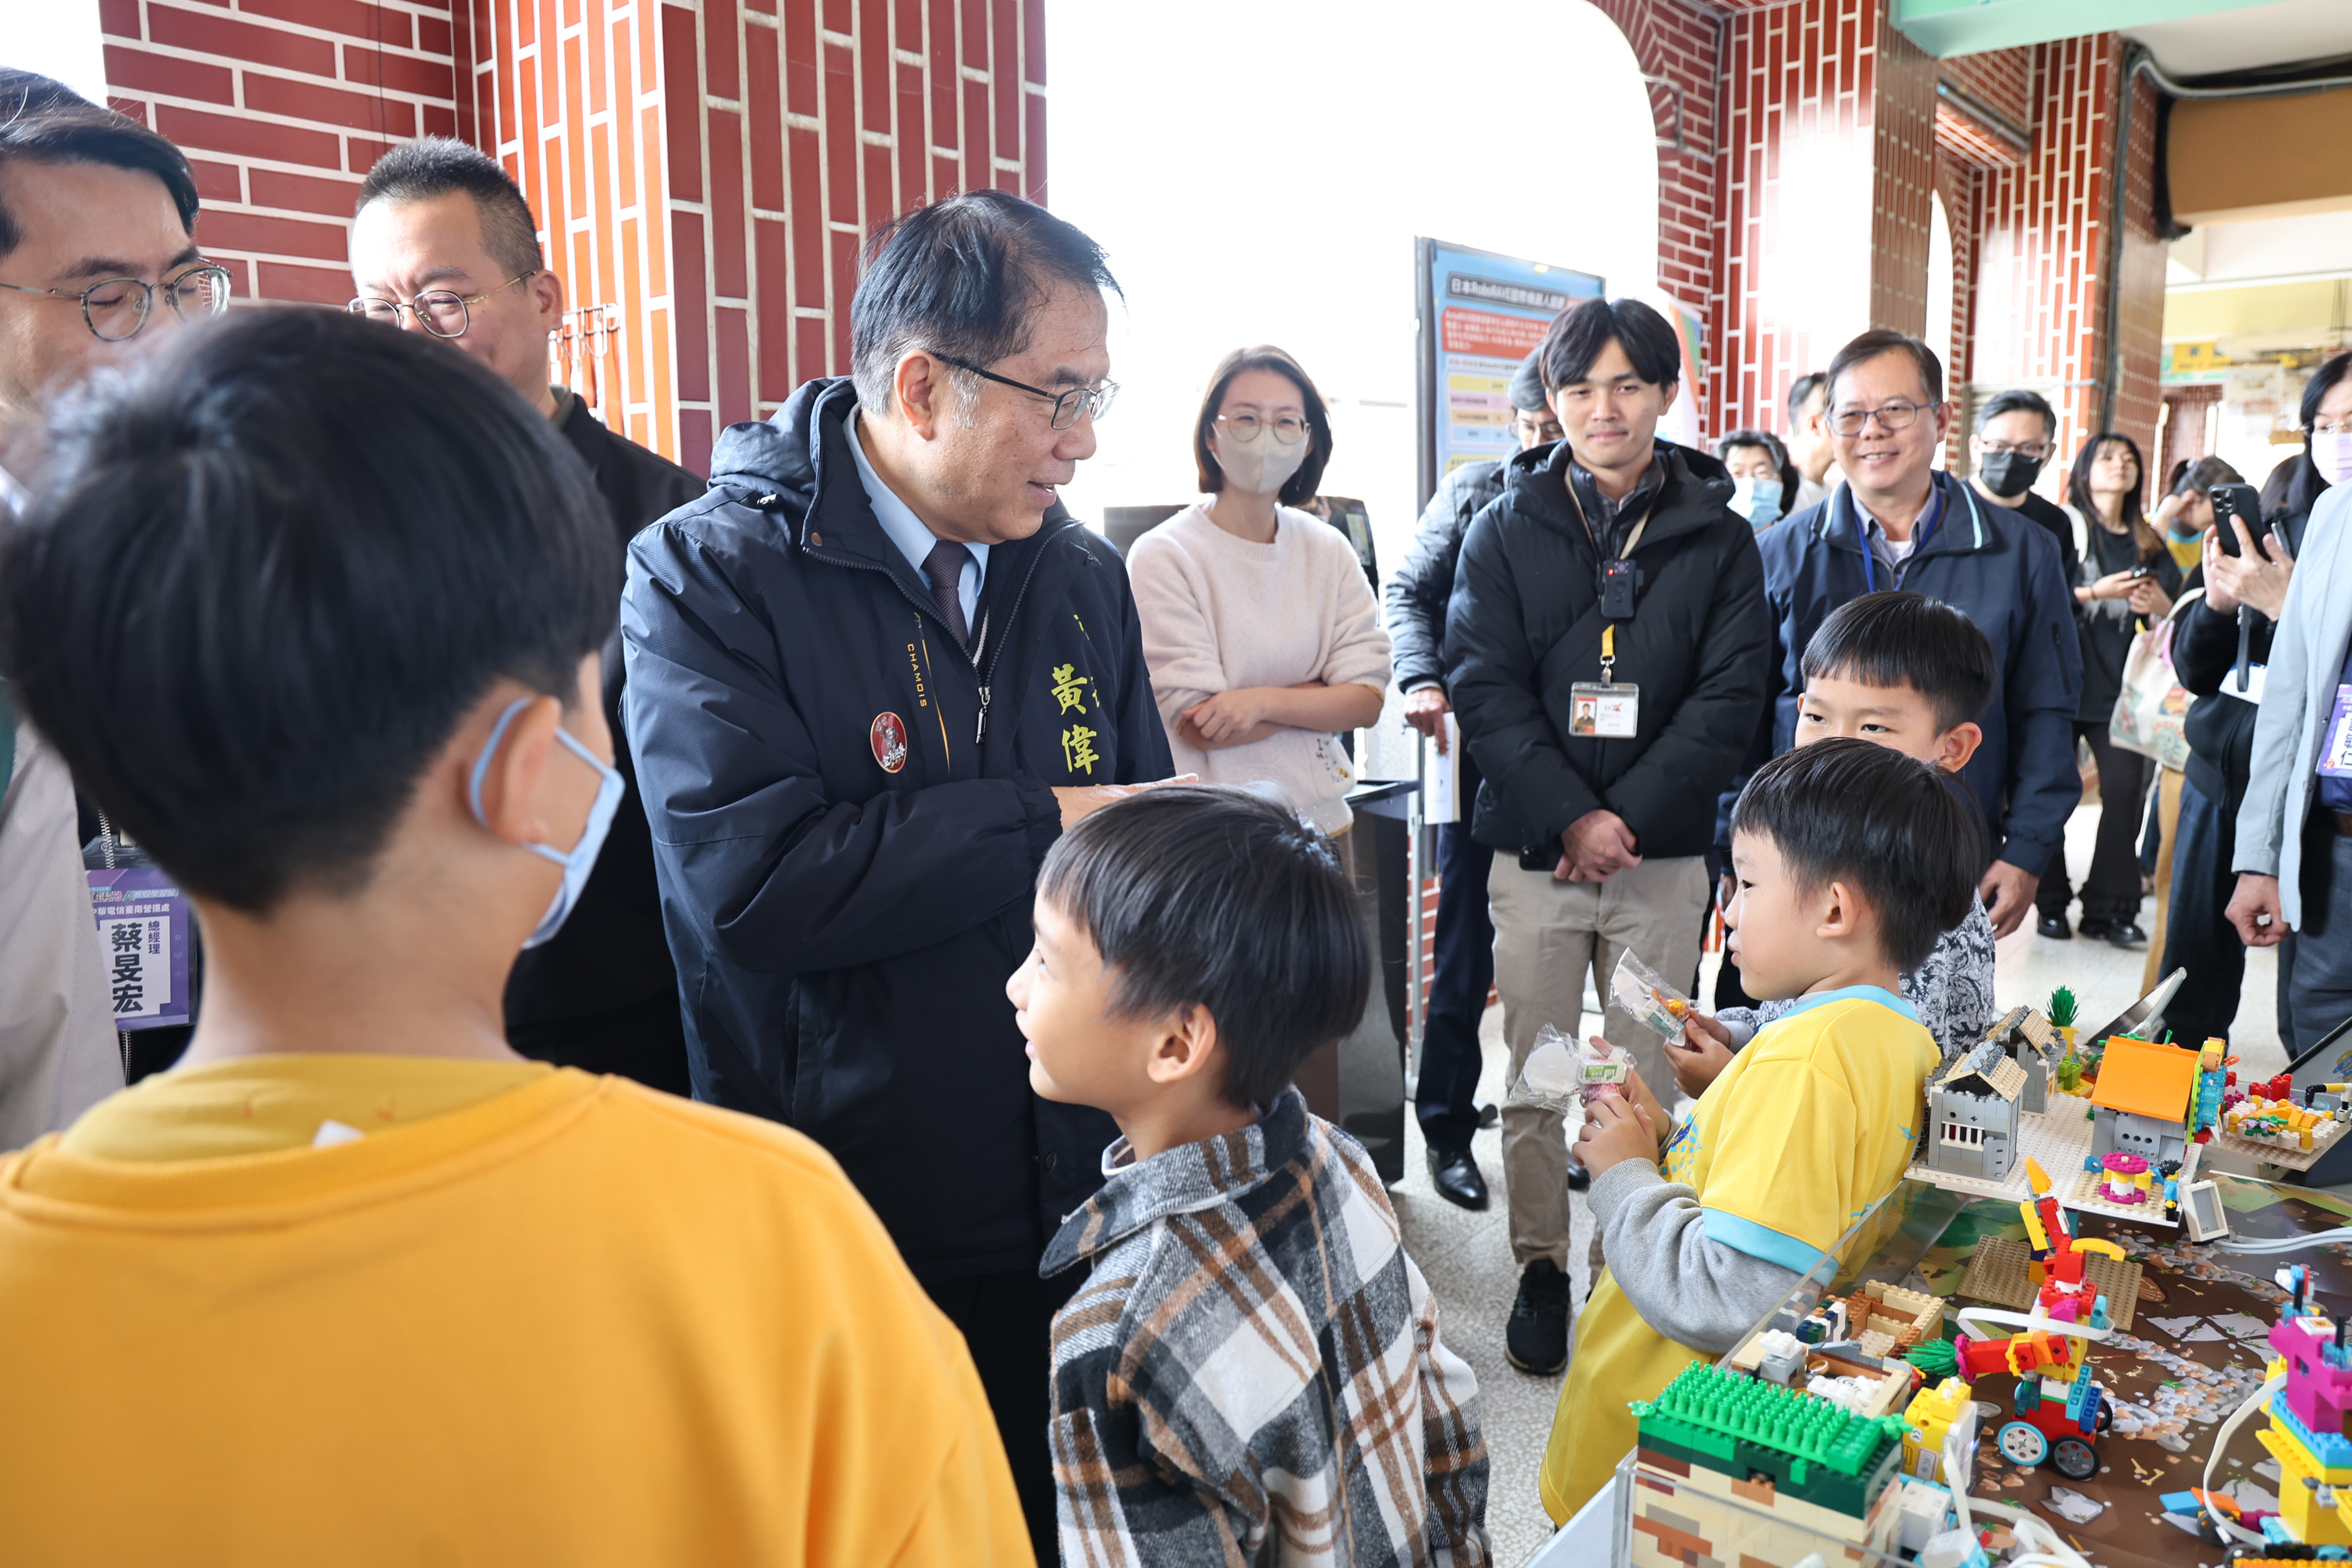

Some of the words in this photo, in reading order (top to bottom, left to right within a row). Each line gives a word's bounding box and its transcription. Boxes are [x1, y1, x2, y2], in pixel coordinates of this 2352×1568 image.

[907, 644, 928, 707] CHAMOIS
[1051, 663, 1101, 787] 黃偉
[111, 923, 144, 1013] 蔡旻宏
[147, 920, 160, 954] 總經理
